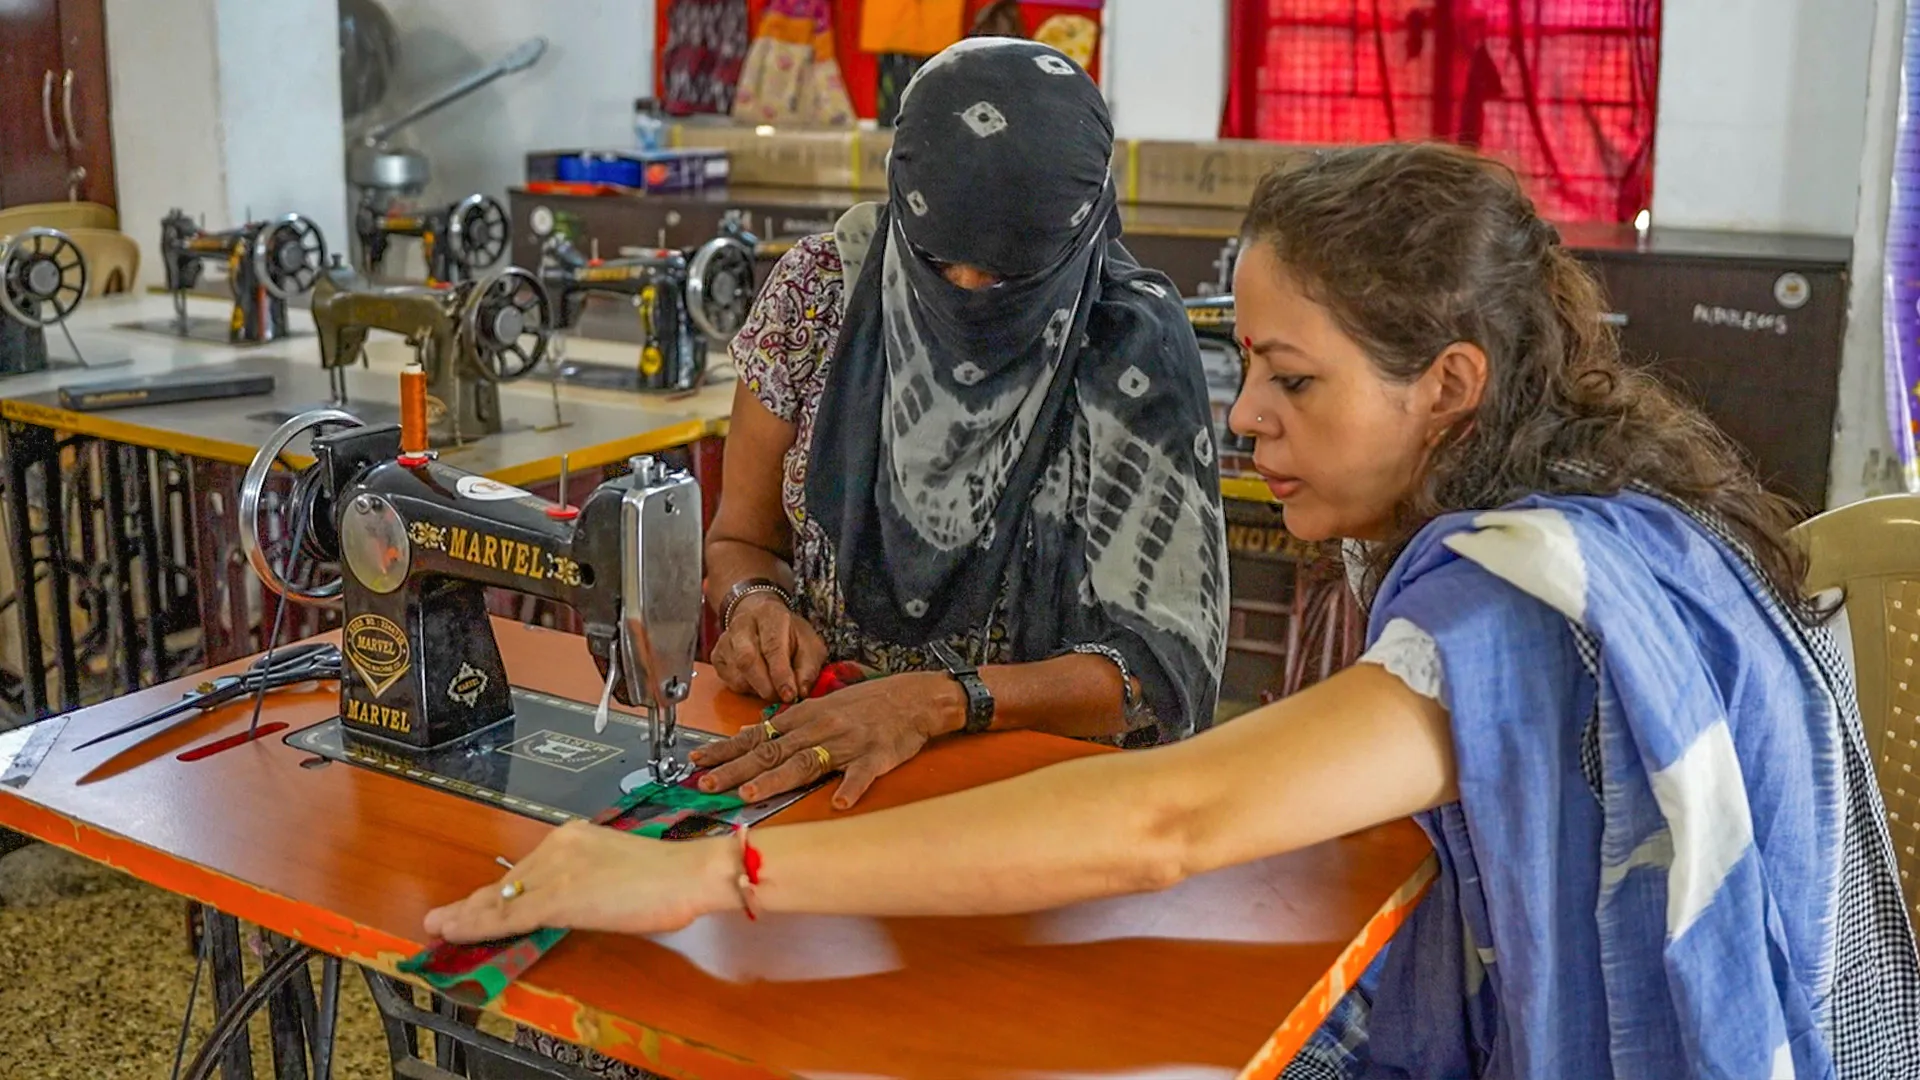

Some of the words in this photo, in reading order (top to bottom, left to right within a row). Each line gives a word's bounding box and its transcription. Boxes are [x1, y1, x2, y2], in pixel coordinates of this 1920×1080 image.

[449, 526, 545, 580] MARVEL
[356, 635, 395, 656] MARVEL
[347, 698, 411, 733] MARVEL
